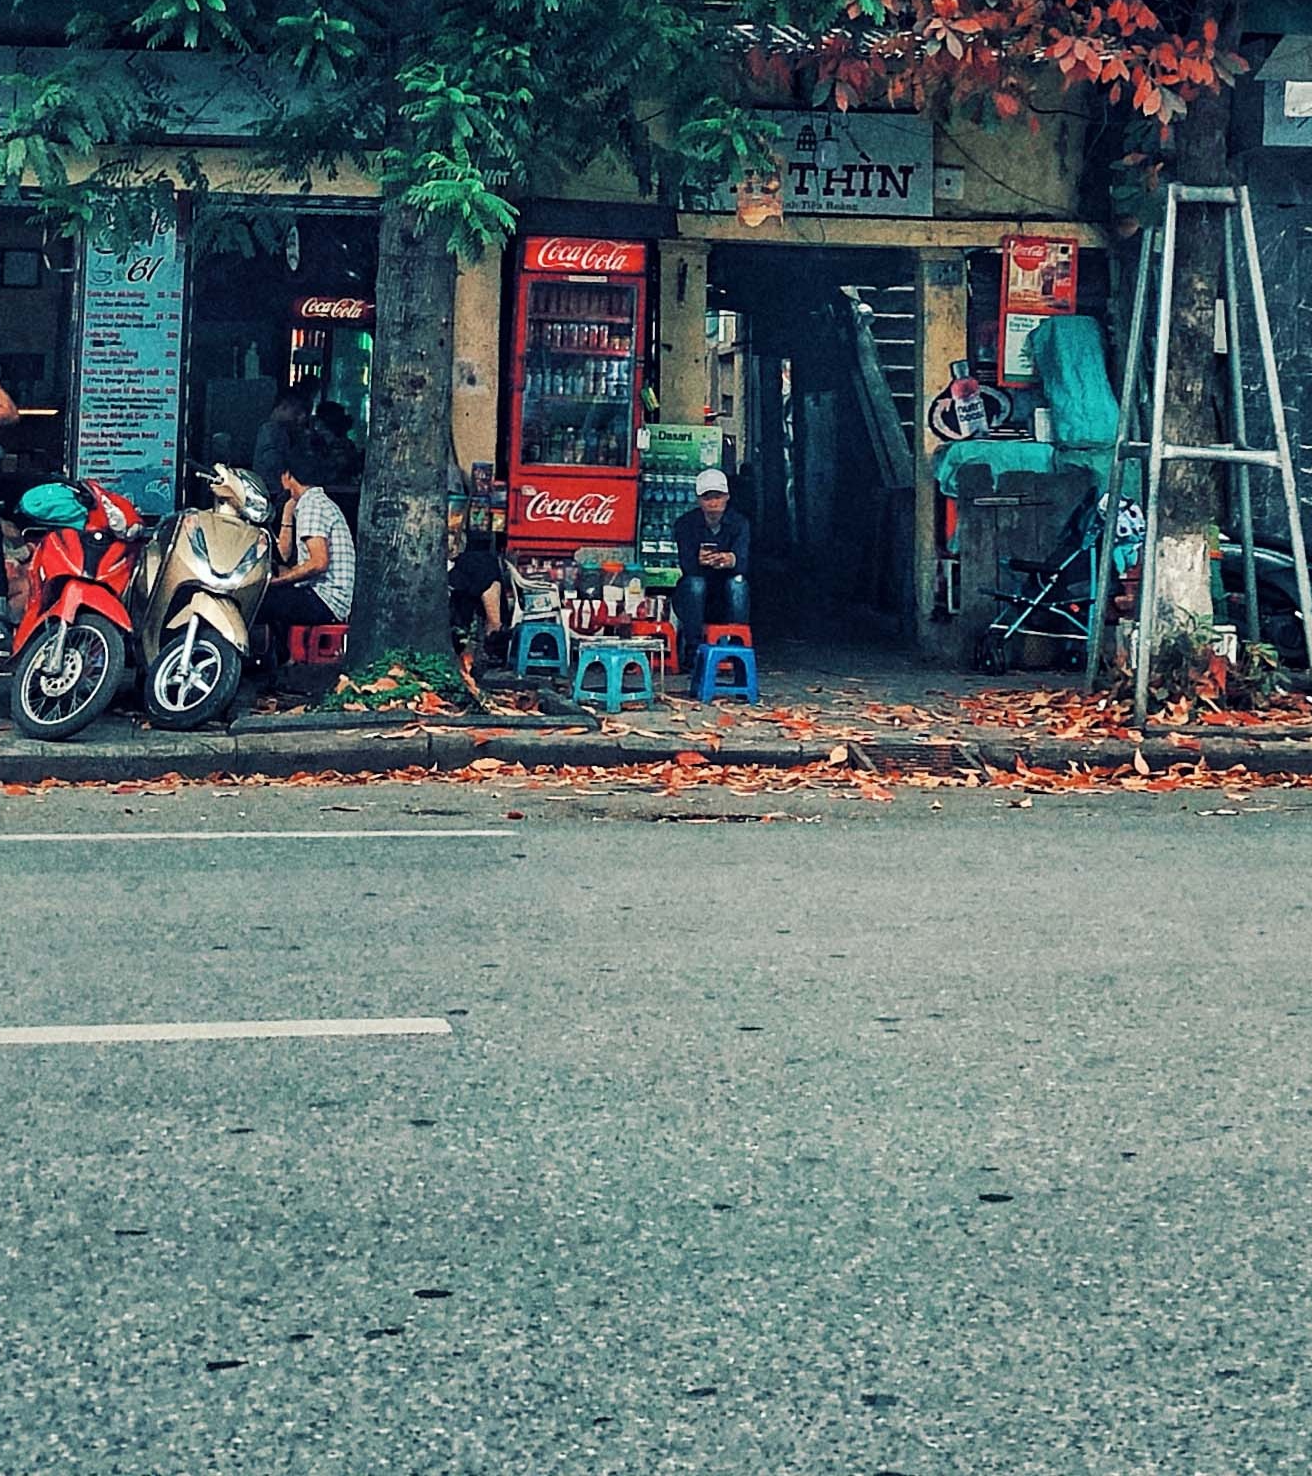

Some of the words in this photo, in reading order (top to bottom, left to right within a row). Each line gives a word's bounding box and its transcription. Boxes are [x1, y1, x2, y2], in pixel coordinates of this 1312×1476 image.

[537, 237, 633, 271] Coca-Cola
[127, 256, 165, 283] 61
[300, 296, 365, 319] Coca-Cola
[658, 430, 693, 442] Dasani
[526, 491, 620, 525] Coca-Cola
